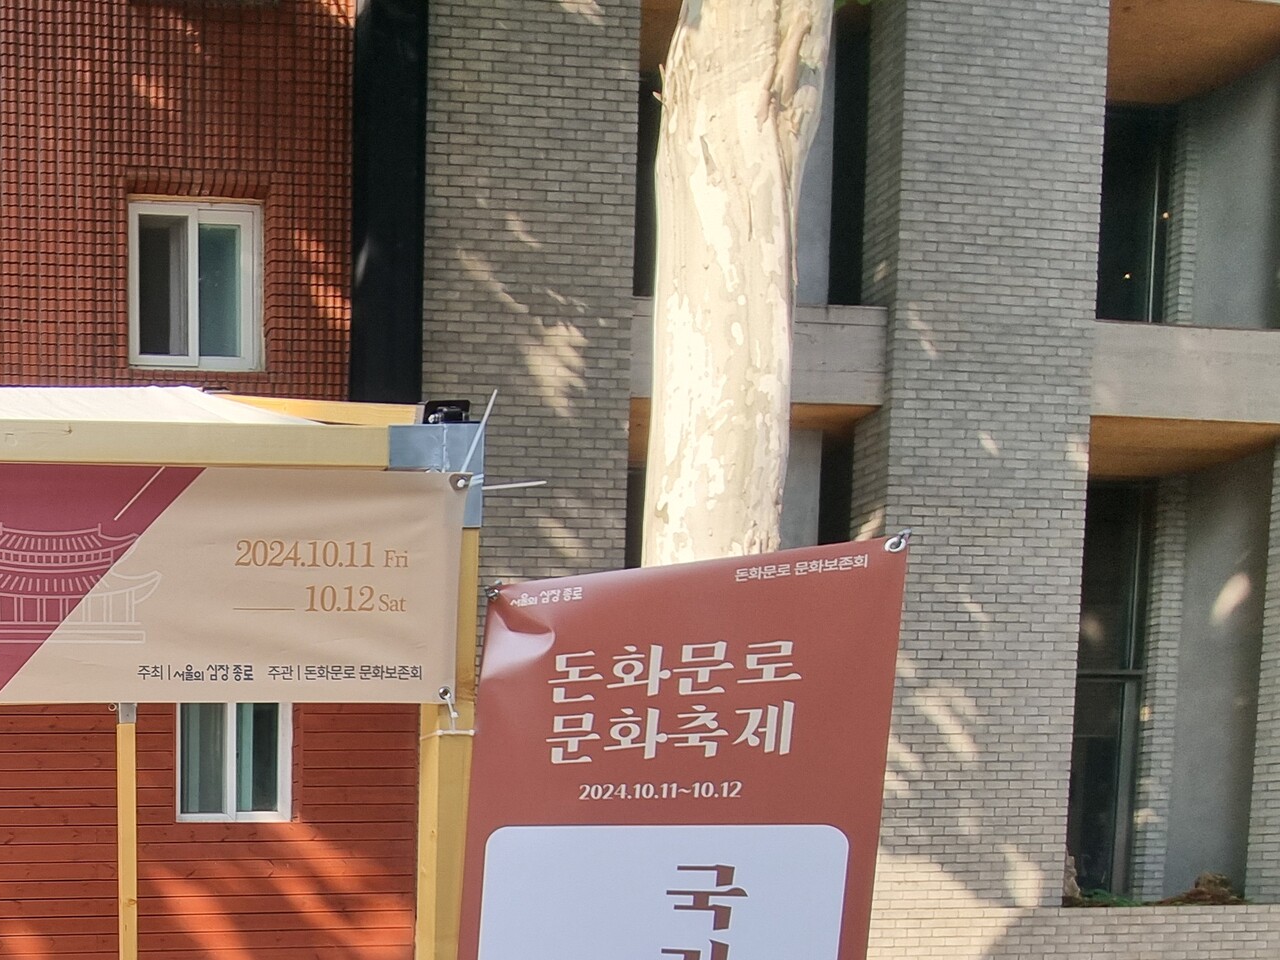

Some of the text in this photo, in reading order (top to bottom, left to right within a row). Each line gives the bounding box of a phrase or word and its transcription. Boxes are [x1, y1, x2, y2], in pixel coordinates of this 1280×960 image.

[234, 540, 409, 568] 2024.10.11 Fri
[735, 554, 869, 582] 돈화문로 문화보존회
[305, 585, 407, 612] 10.12 Sat
[137, 664, 254, 681] 주최 서울의 심장 종로
[268, 665, 422, 680] 주관 돈화문로 문화보존회
[548, 640, 802, 704] 돈화문로
[545, 700, 795, 765] 문화축제
[578, 780, 743, 800] 2024.10.11~10.12
